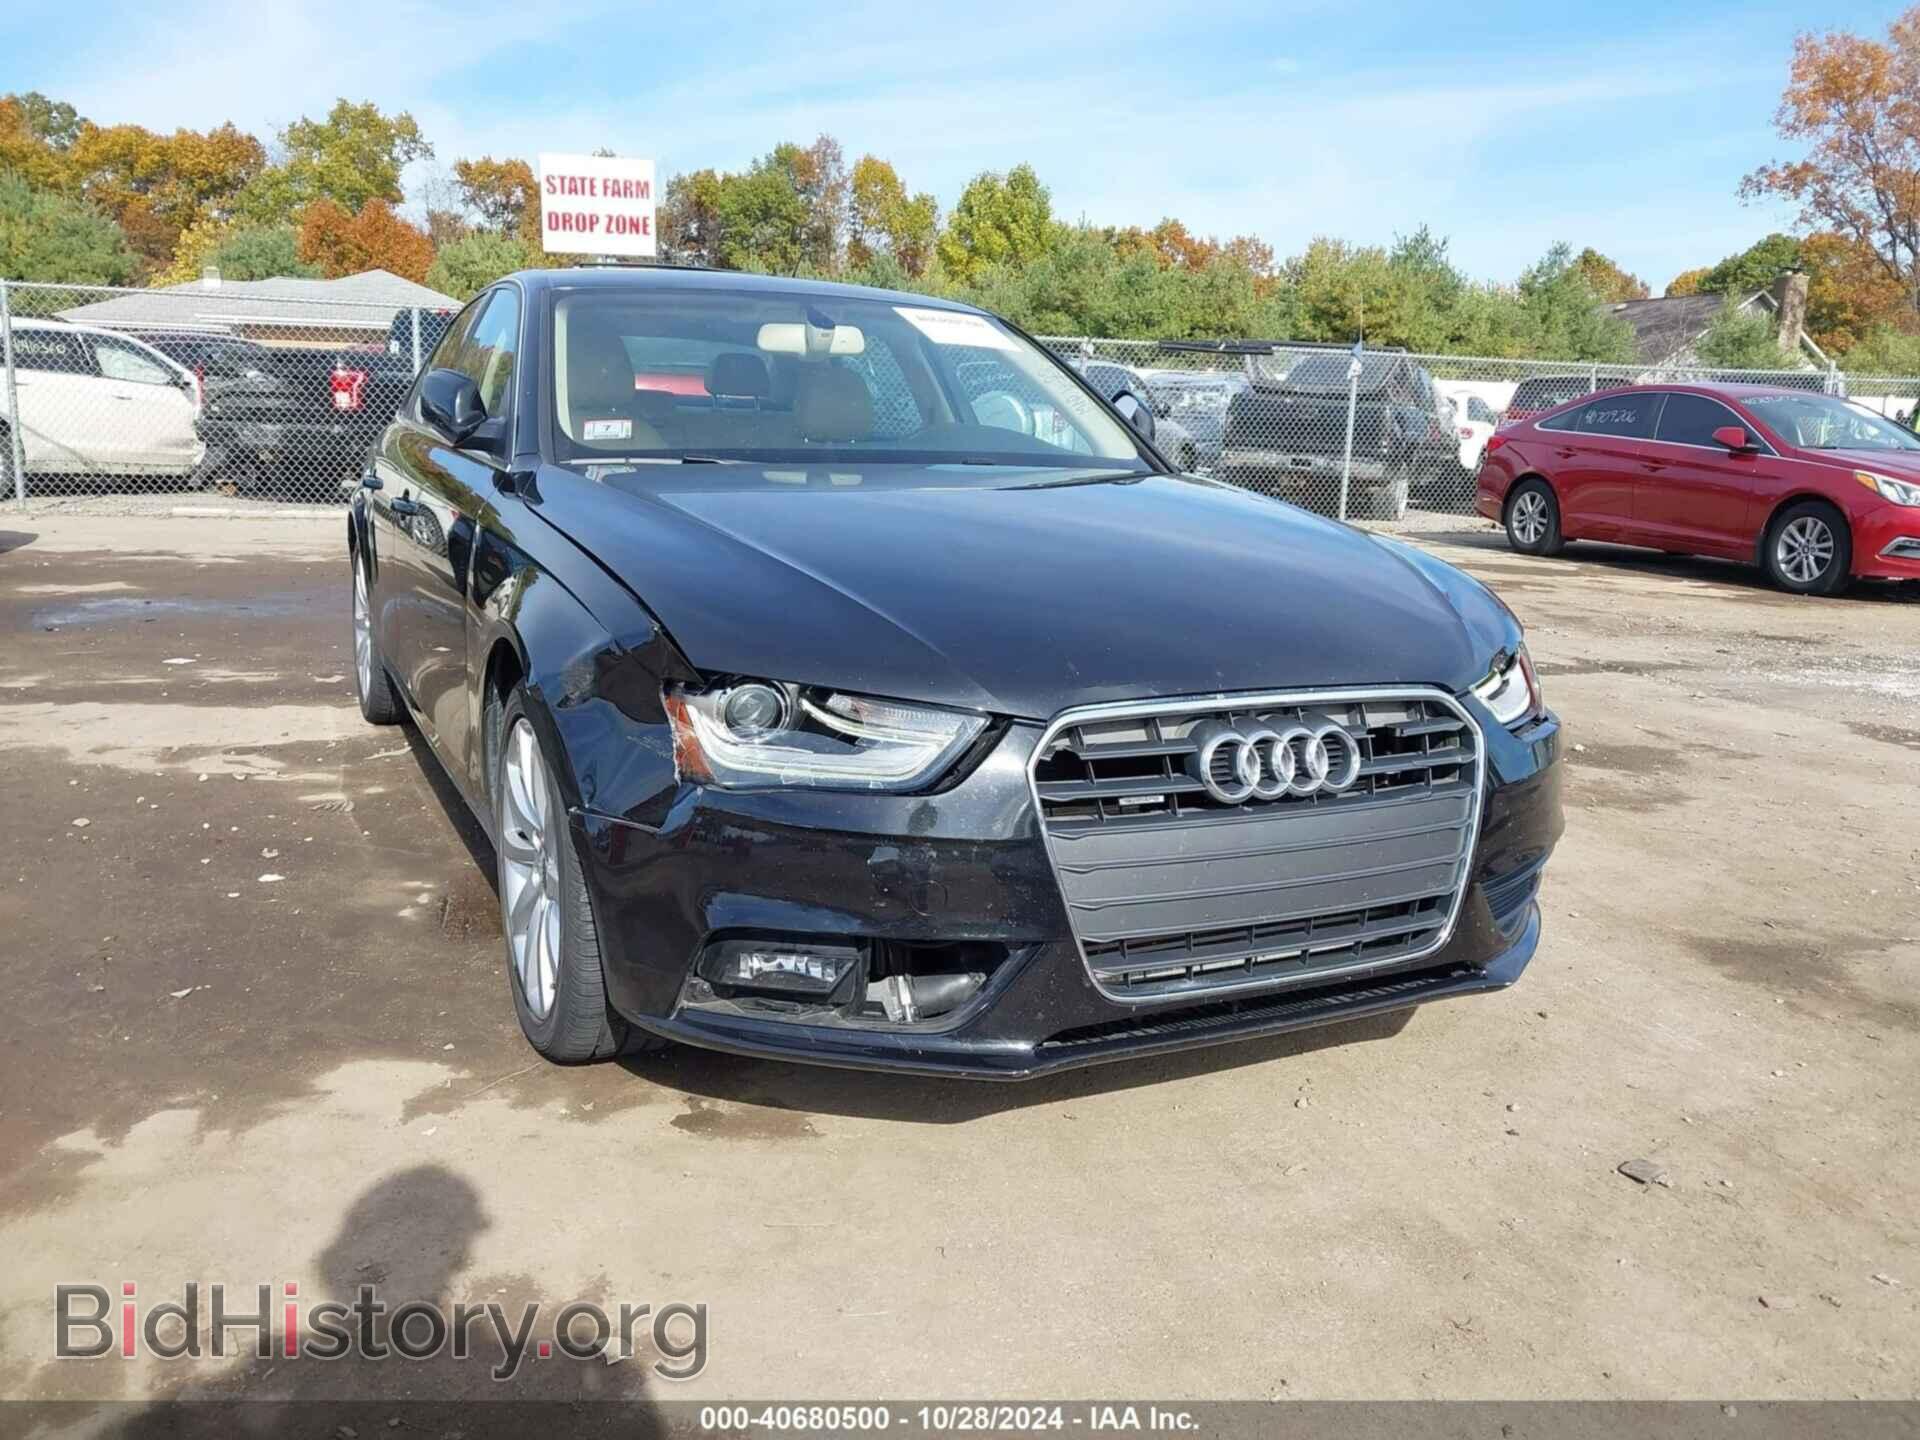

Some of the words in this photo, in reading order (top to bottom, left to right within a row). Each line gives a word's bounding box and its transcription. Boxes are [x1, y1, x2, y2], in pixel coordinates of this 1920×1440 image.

[545, 174, 597, 196] STATE
[602, 178, 650, 200] FARM
[547, 211, 600, 233] DROP
[605, 214, 650, 236] ZONE
